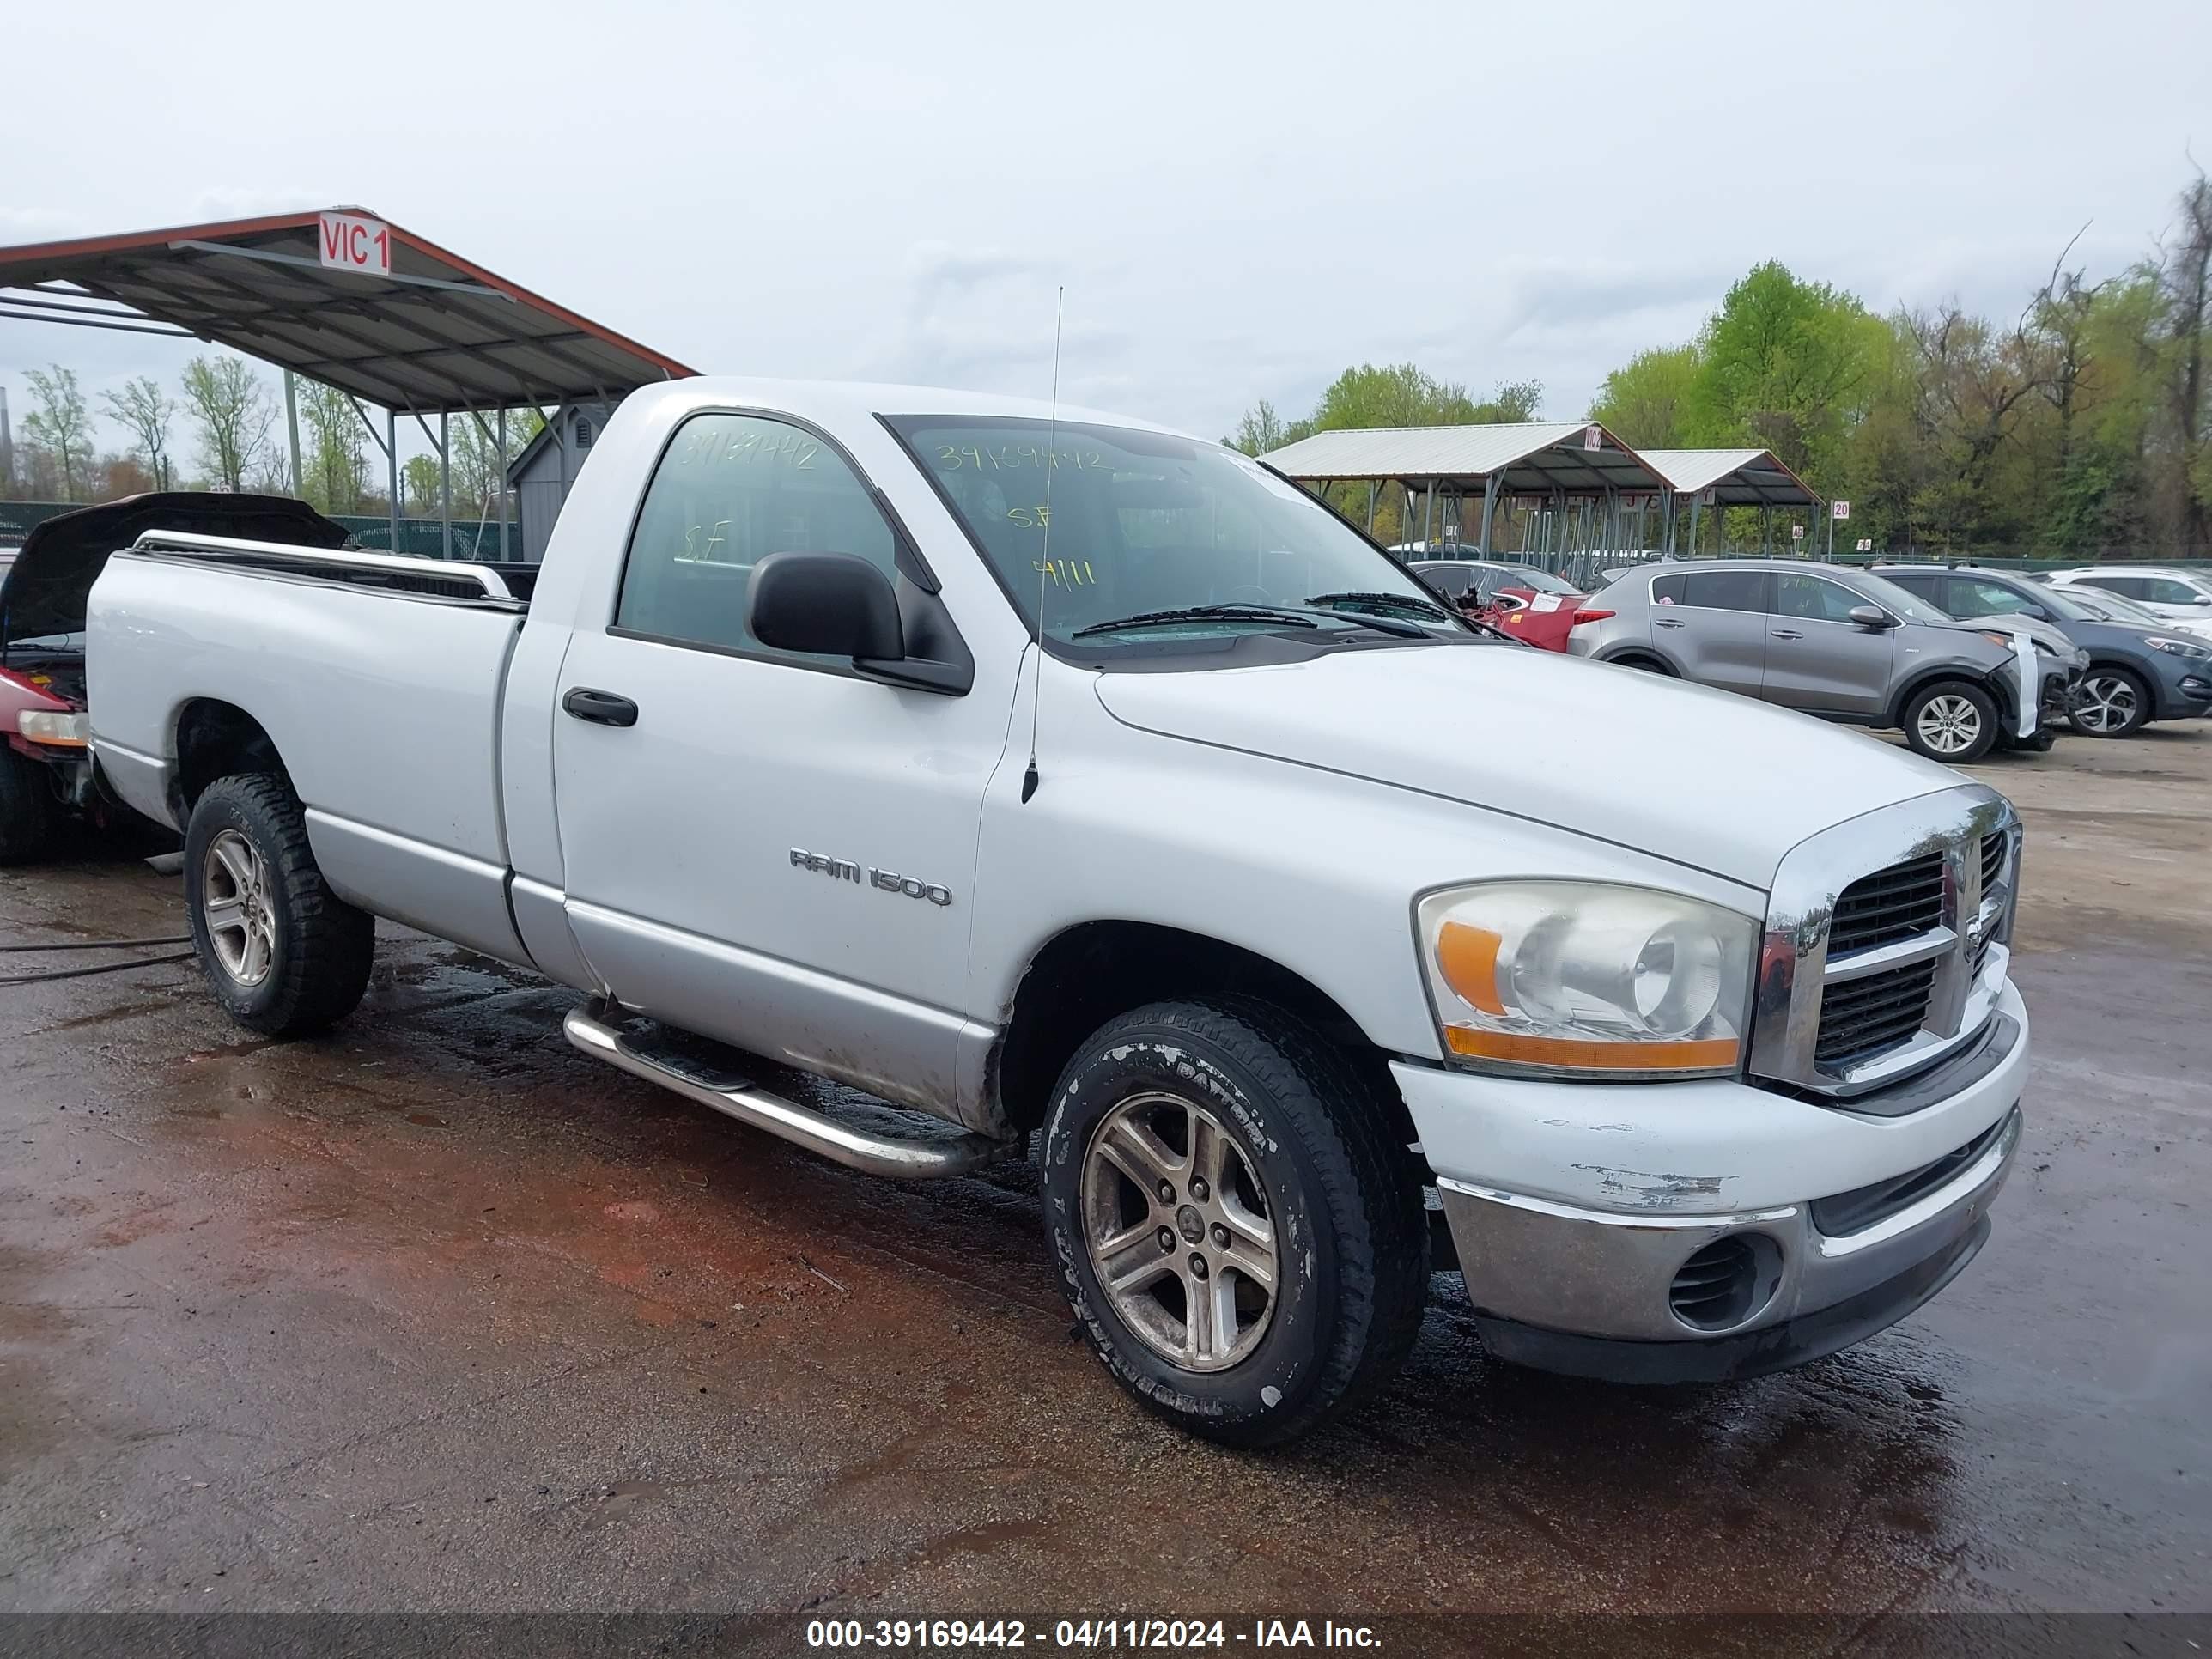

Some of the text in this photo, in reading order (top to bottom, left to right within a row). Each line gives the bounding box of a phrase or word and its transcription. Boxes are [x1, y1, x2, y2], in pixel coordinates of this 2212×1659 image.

[321, 218, 387, 269] VIC 1
[1835, 504, 1848, 515] 20
[789, 846, 953, 907] RAM 1500
